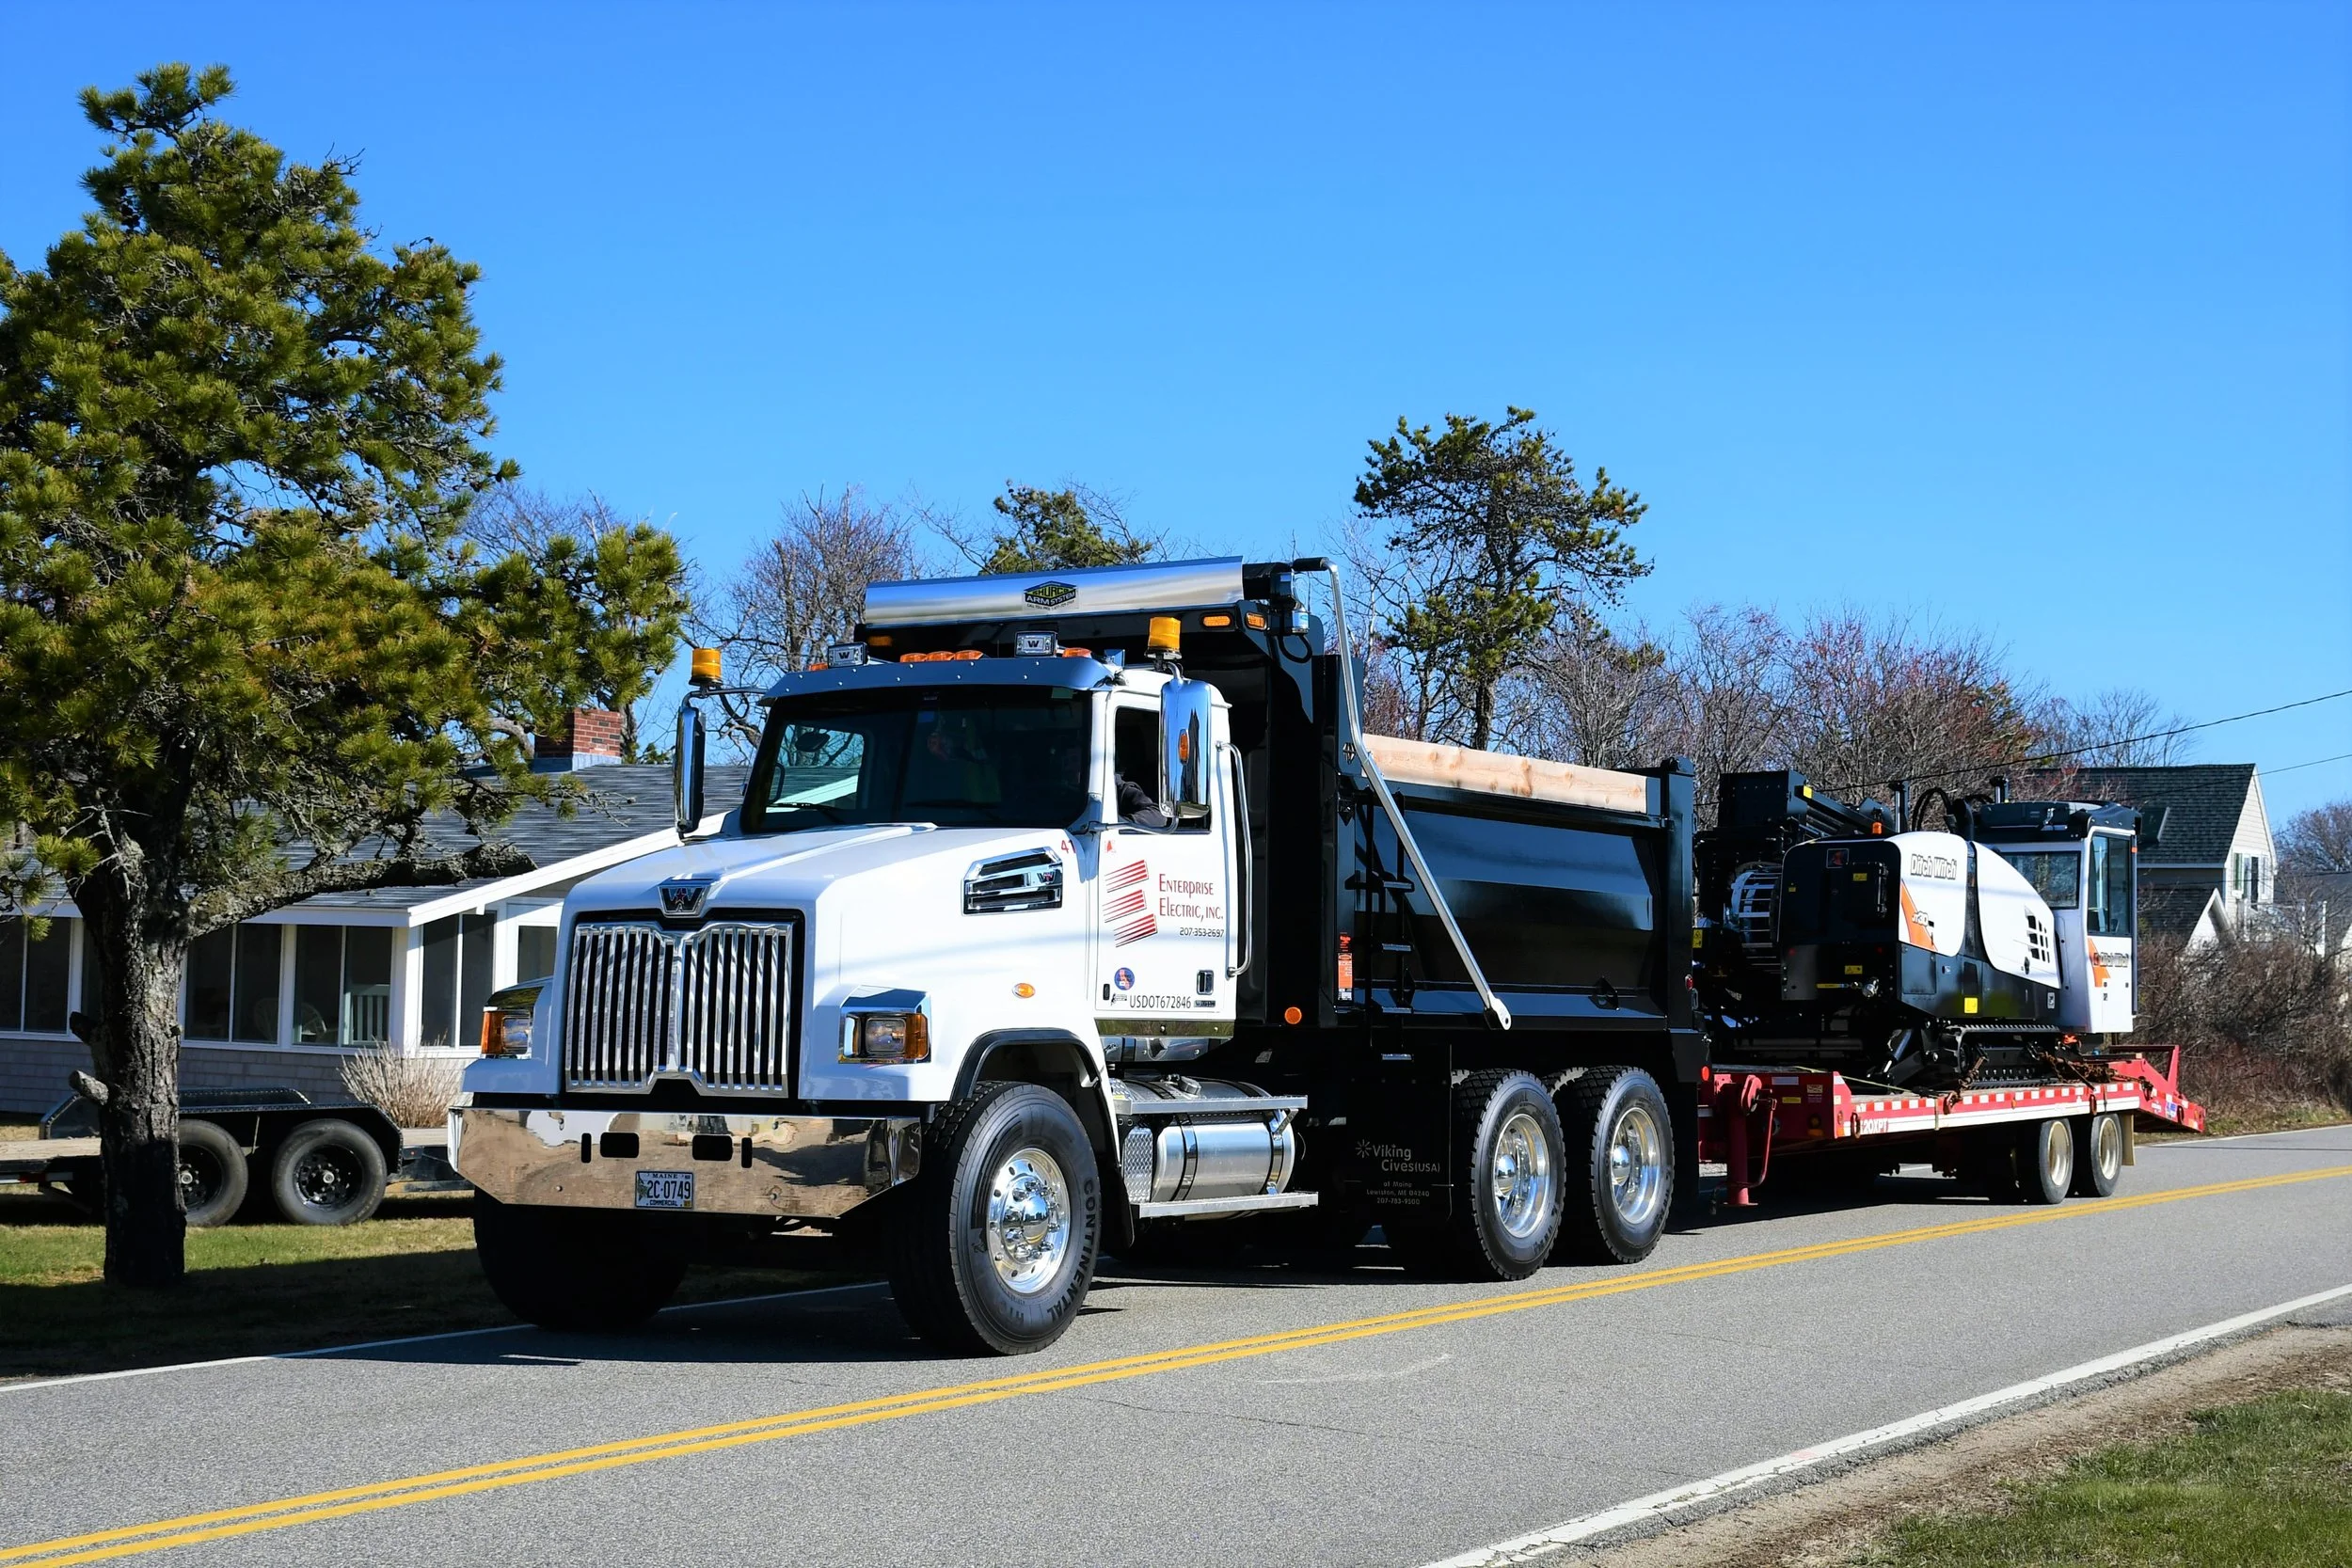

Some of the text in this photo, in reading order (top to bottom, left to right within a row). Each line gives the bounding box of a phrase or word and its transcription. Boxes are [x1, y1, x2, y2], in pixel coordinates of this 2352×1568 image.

[1026, 591, 1075, 605] ARM SYSTEM
[1911, 853, 1957, 880] Ditch Witch
[1373, 1144, 1412, 1161] Viking
[1046, 1179, 1098, 1324] CONTINENTAL
